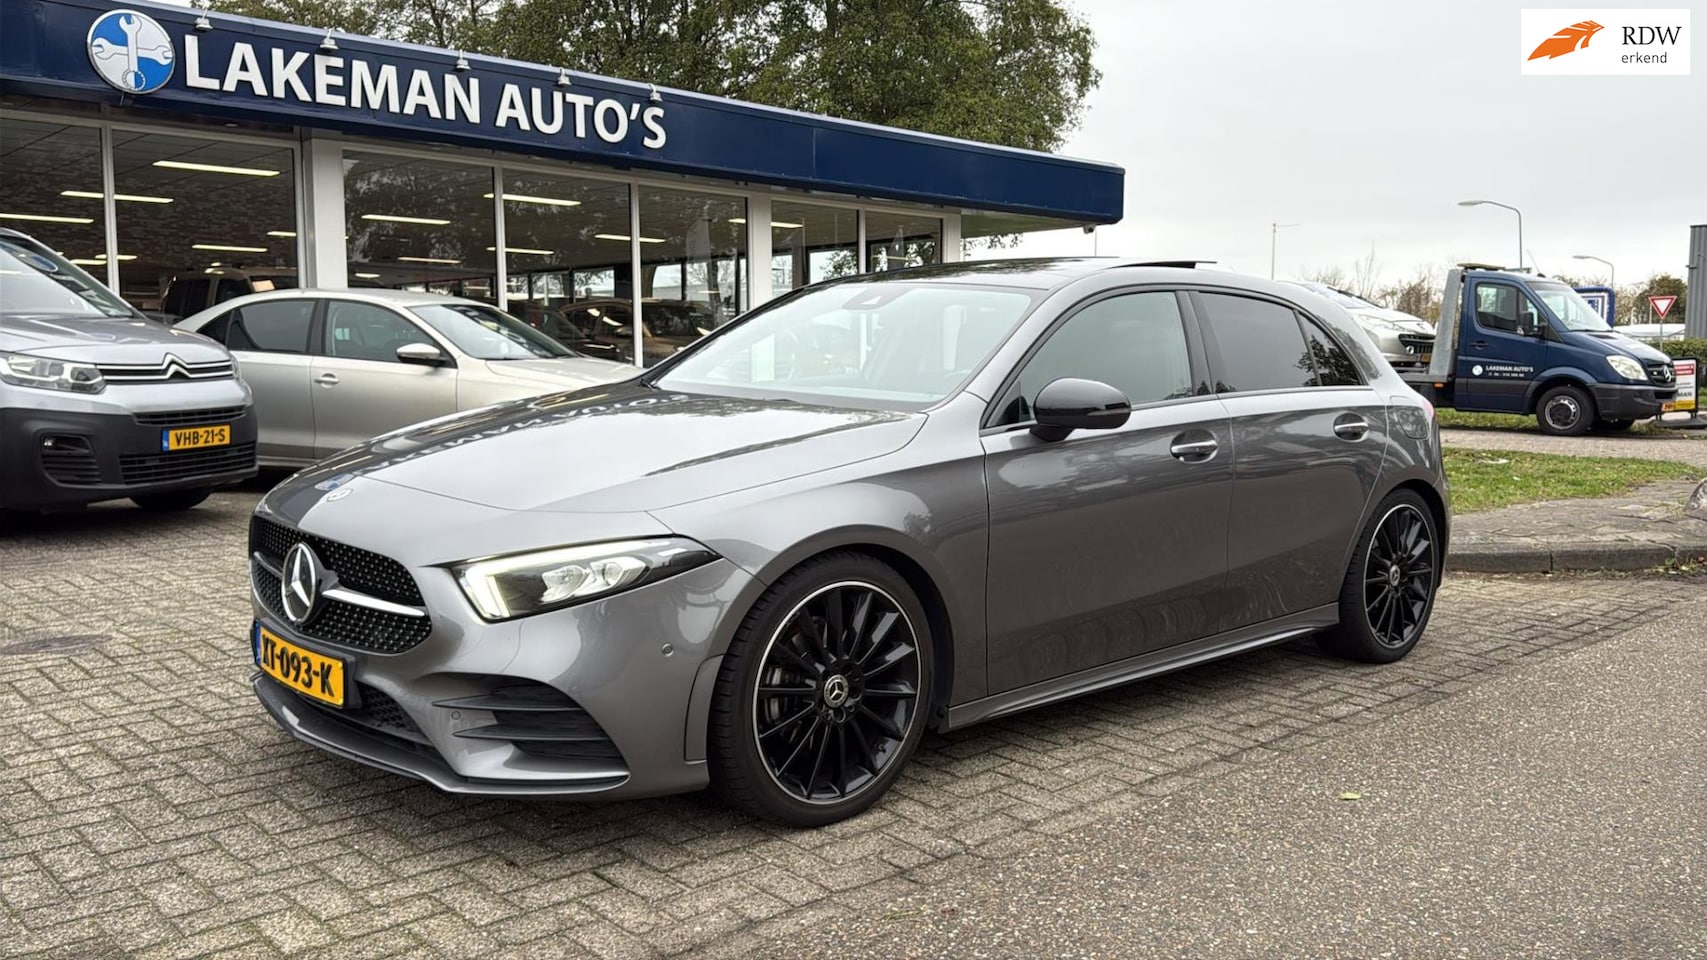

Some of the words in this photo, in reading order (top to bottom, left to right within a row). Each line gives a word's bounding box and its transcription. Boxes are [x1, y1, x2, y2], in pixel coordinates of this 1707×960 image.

[184, 34, 481, 124] LAKEMAN
[494, 82, 668, 150] AUTO'S
[174, 428, 226, 447] VHB-21-S
[262, 634, 335, 698] XT-093-K
